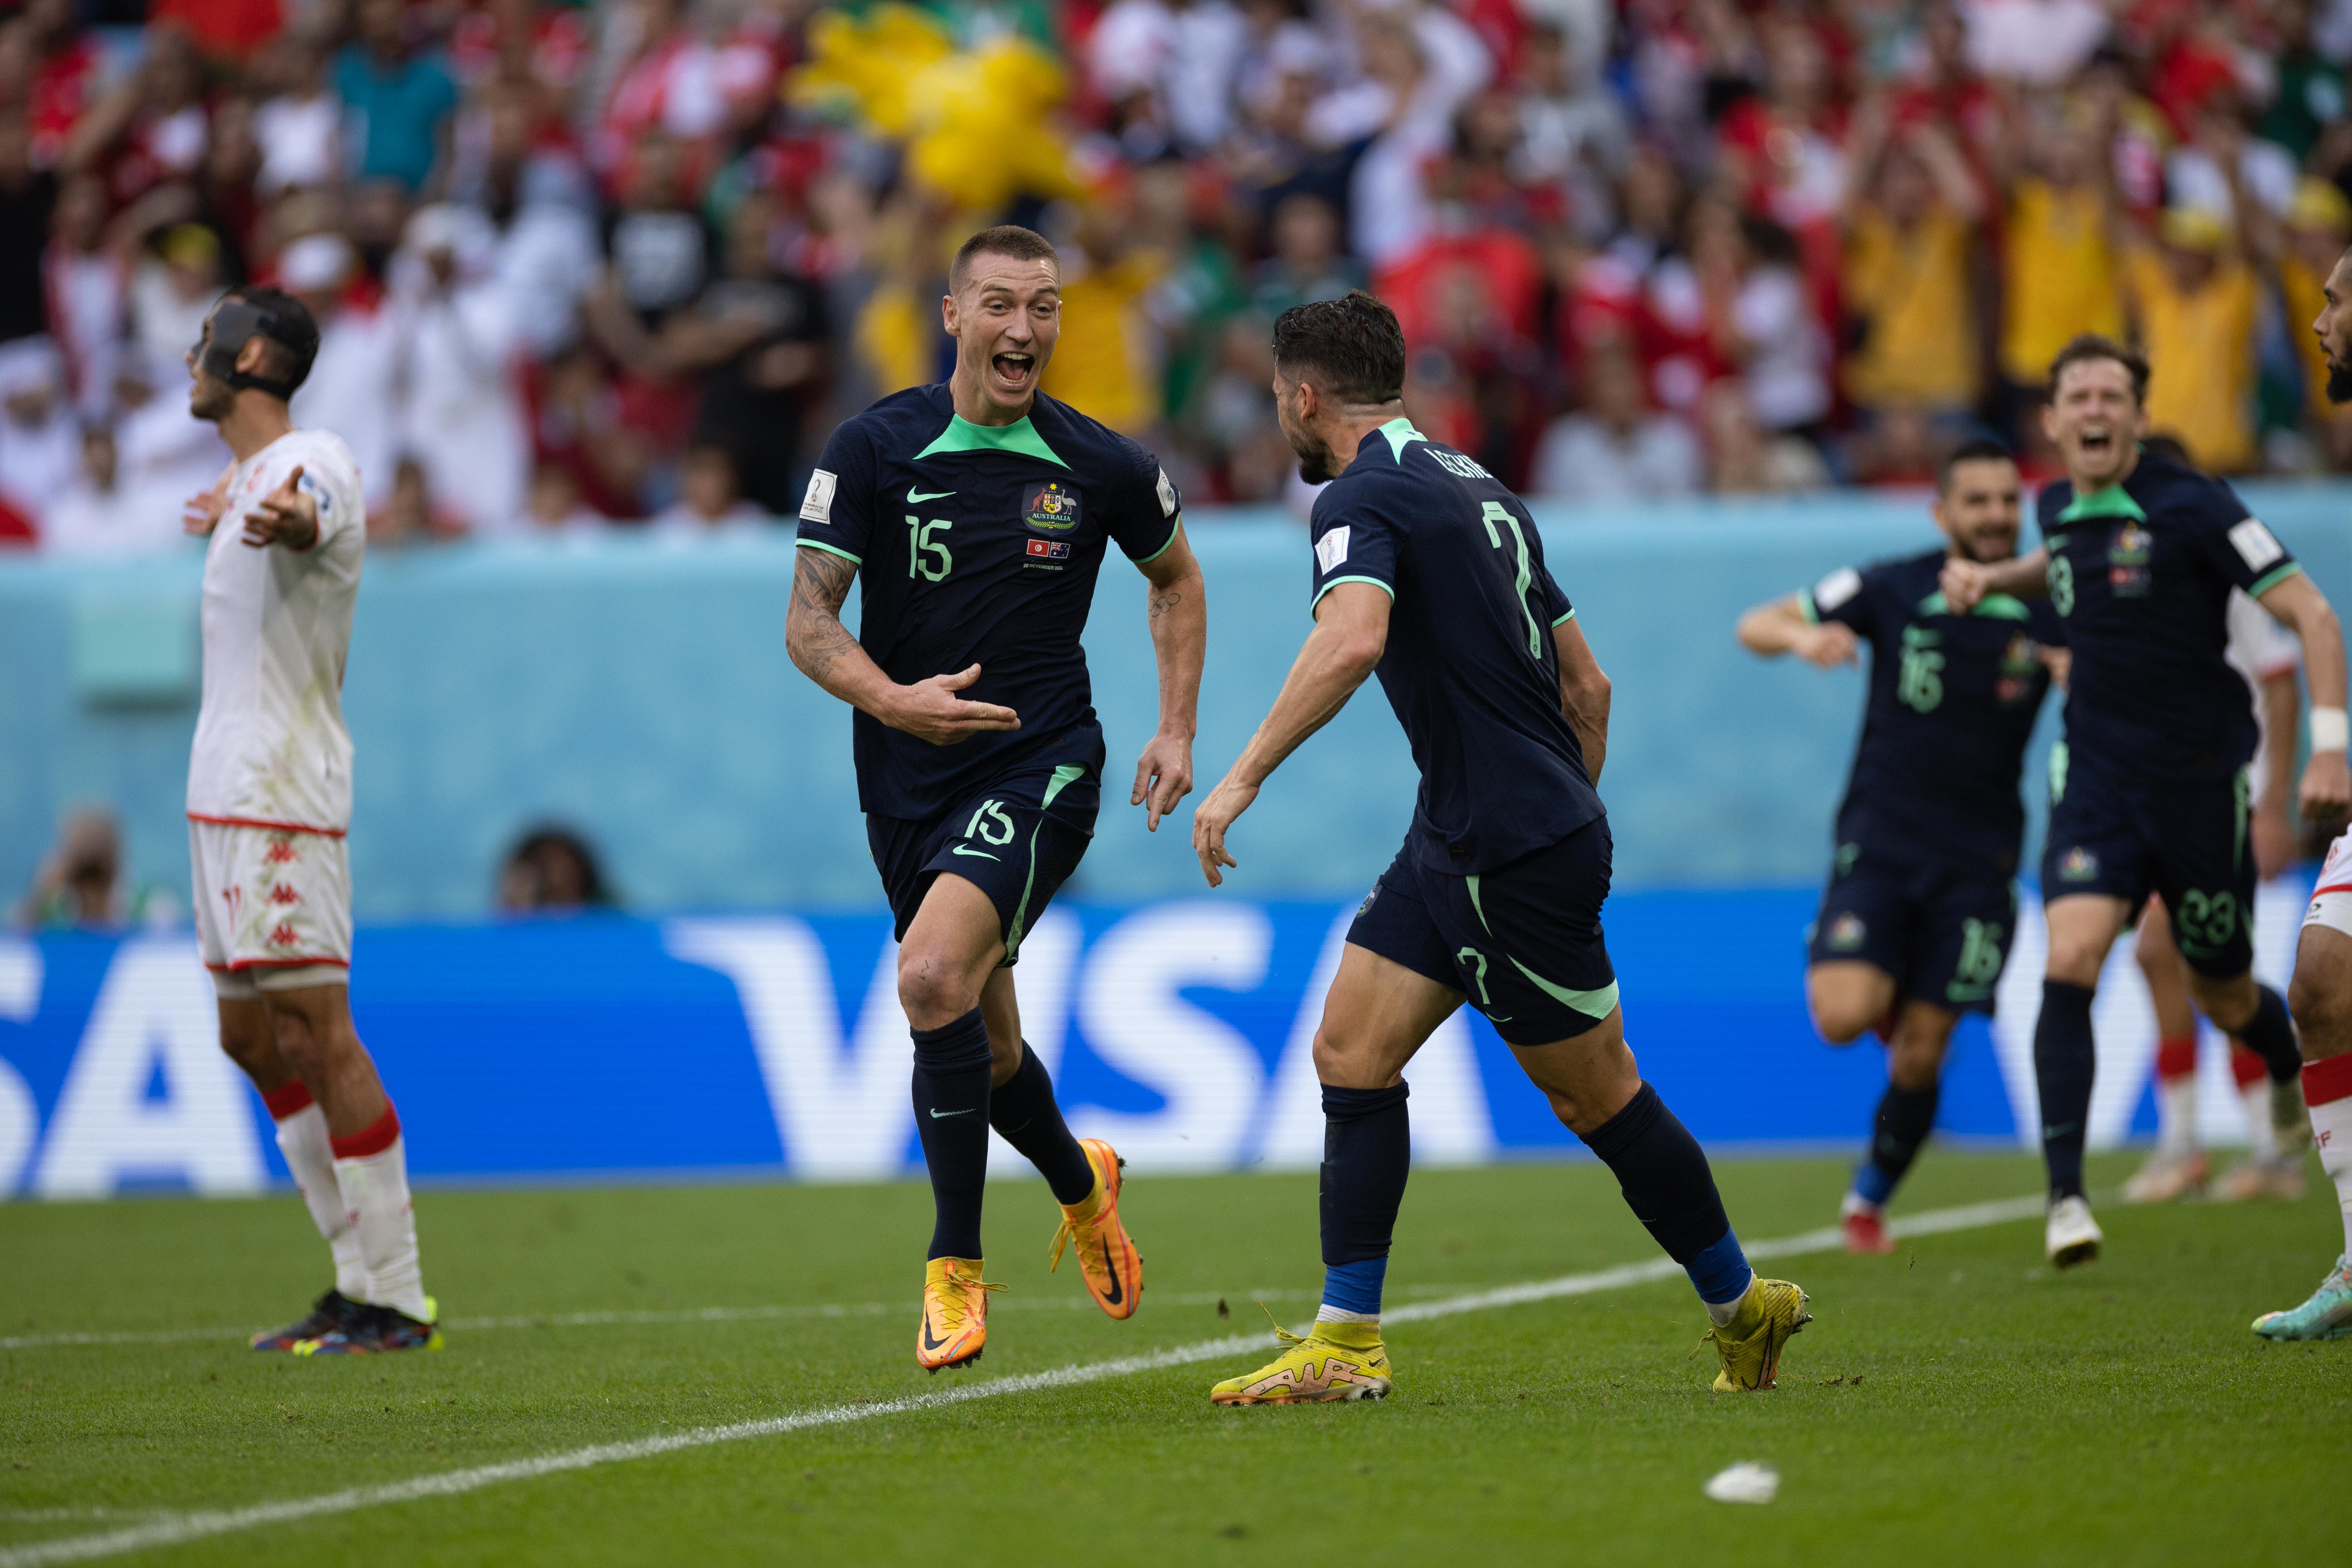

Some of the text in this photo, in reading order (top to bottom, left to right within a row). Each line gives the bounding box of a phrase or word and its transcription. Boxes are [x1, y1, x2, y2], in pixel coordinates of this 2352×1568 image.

[1032, 513, 1071, 521] AUSTRALIA
[906, 515, 952, 582] 15
[1483, 501, 1541, 659] 7
[964, 799, 1015, 845] 15
[1457, 947, 1490, 1004] 7
